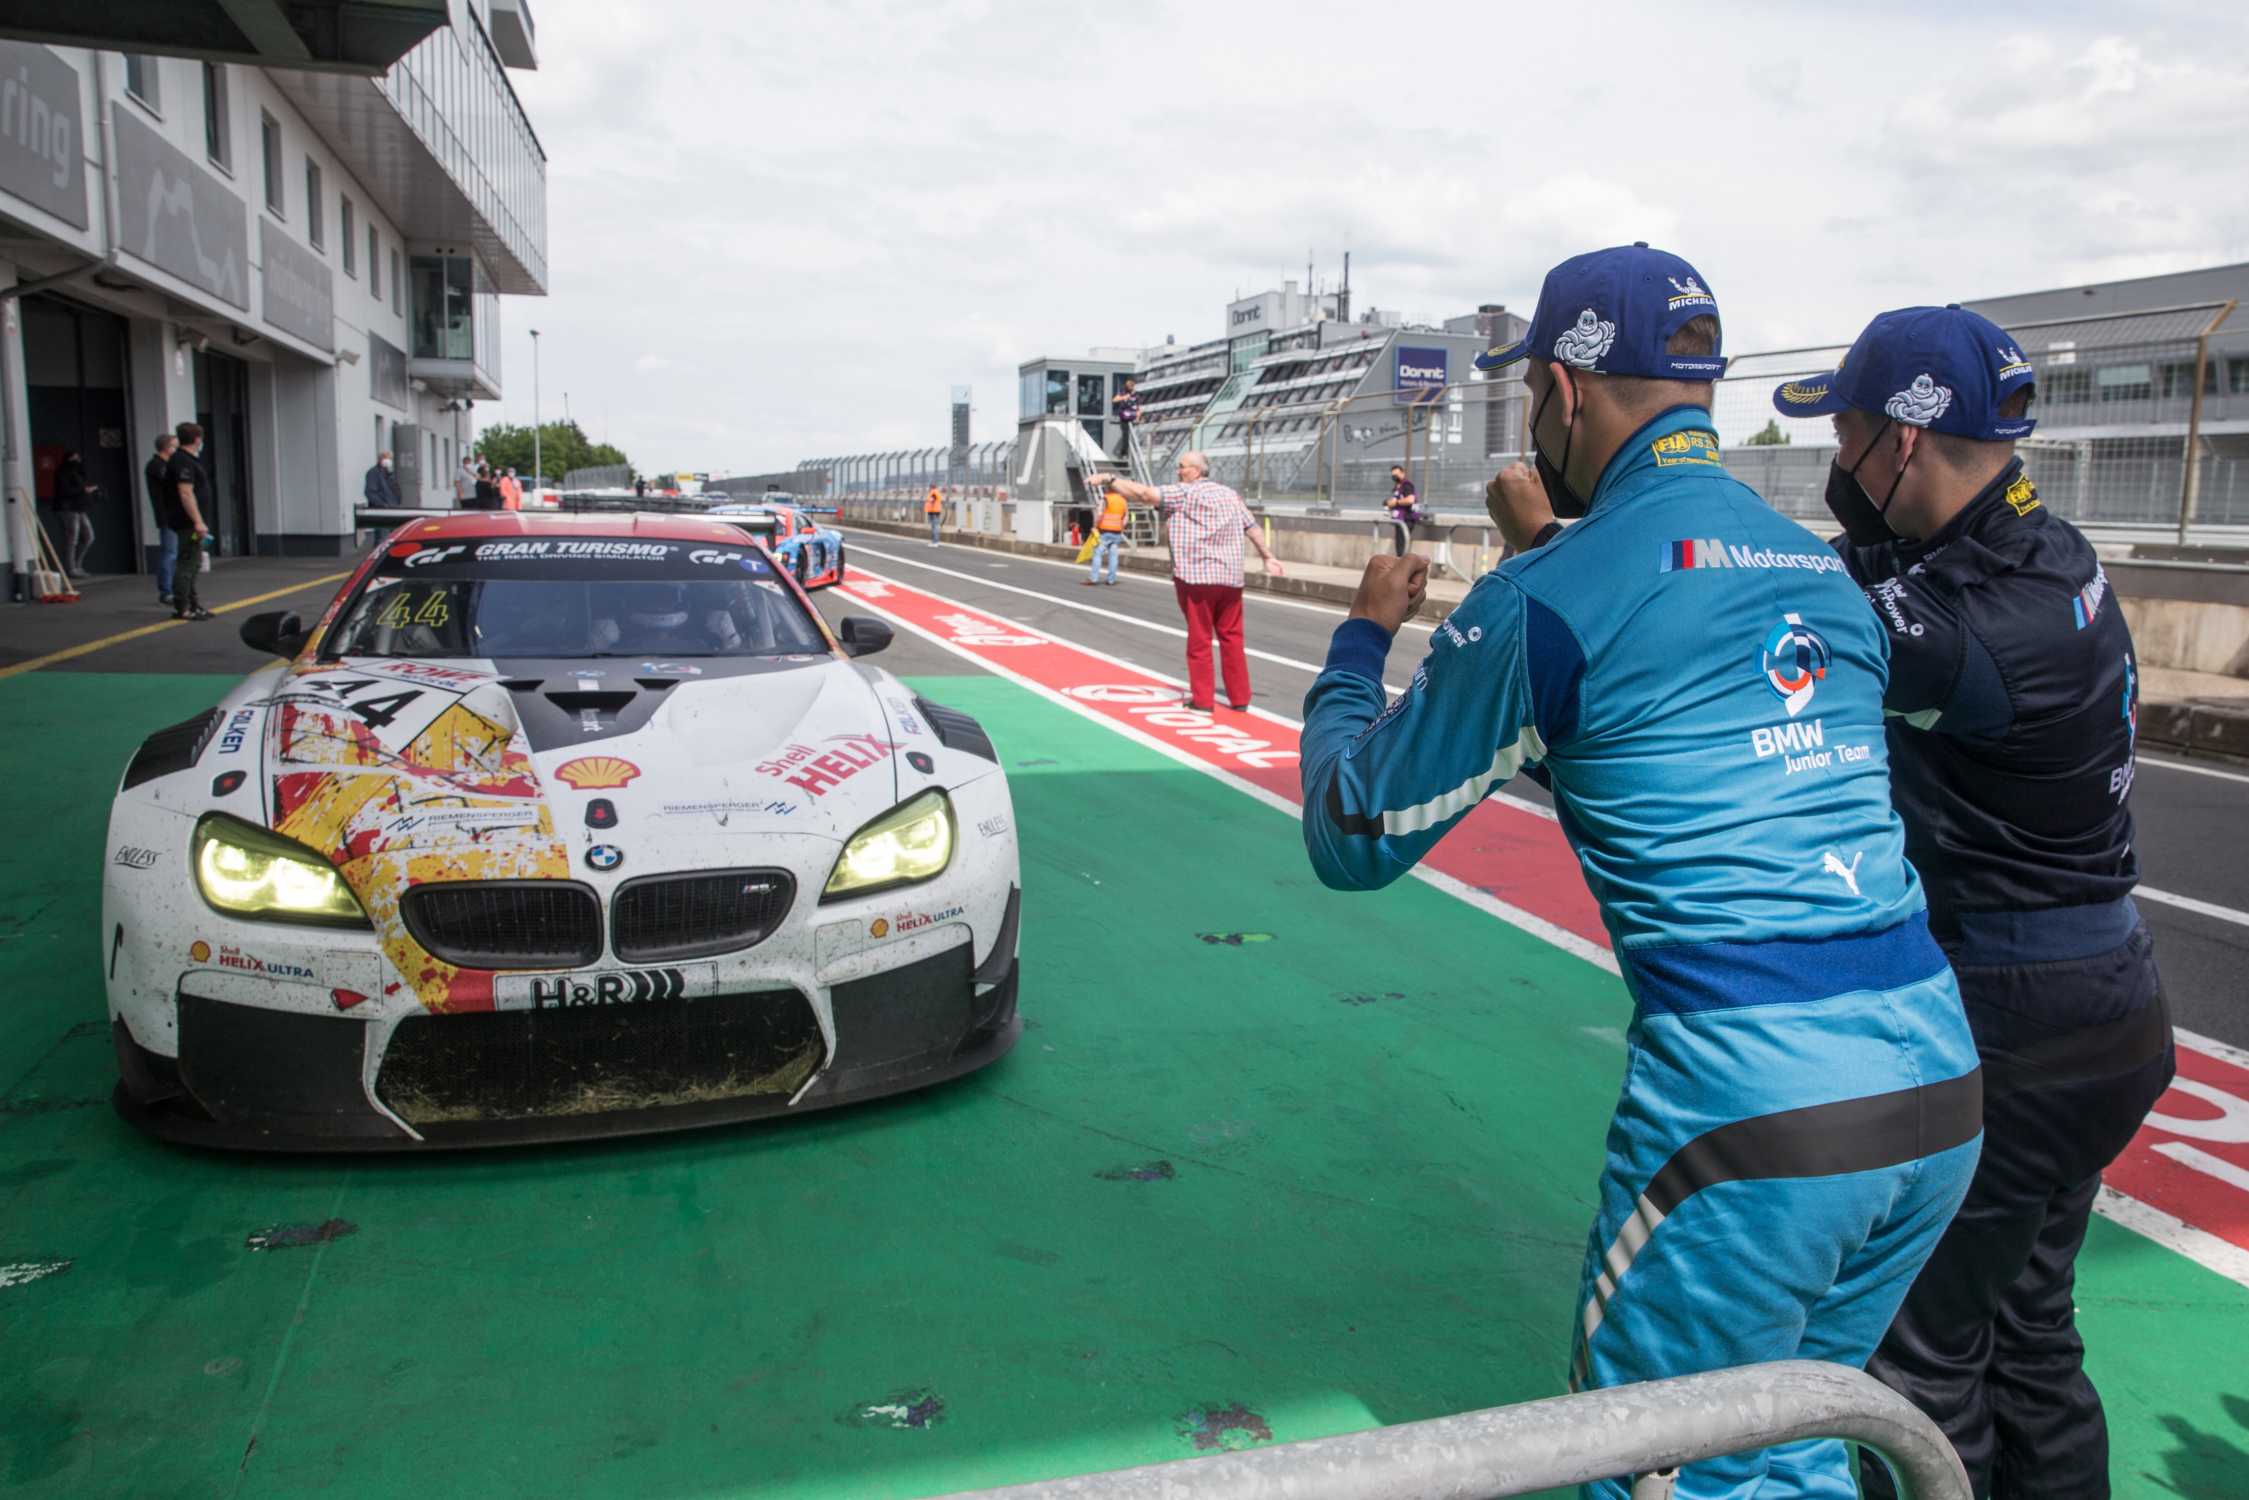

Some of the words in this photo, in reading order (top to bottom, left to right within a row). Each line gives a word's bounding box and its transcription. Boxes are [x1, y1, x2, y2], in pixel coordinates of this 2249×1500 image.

[1232, 304, 1261, 326] Dorint
[1400, 364, 1444, 379] Dorint
[1670, 361, 1722, 371] MOTORSPORT
[475, 541, 548, 556] GRAN
[556, 542, 668, 556] TURISMO
[376, 591, 449, 630] 44
[219, 709, 255, 755] FALKEN
[1128, 706, 1301, 768] TOTAL
[1751, 718, 1824, 759] BMW
[754, 743, 817, 777] Shell
[784, 733, 907, 797] HELIX
[1784, 750, 1832, 776] Junior
[1833, 744, 1870, 764] Team
[896, 913, 934, 933] HELIX
[933, 906, 964, 923] ULTRA
[219, 953, 265, 972] HELIX
[266, 963, 314, 978] ULTRA
[531, 975, 627, 1008] H&R
